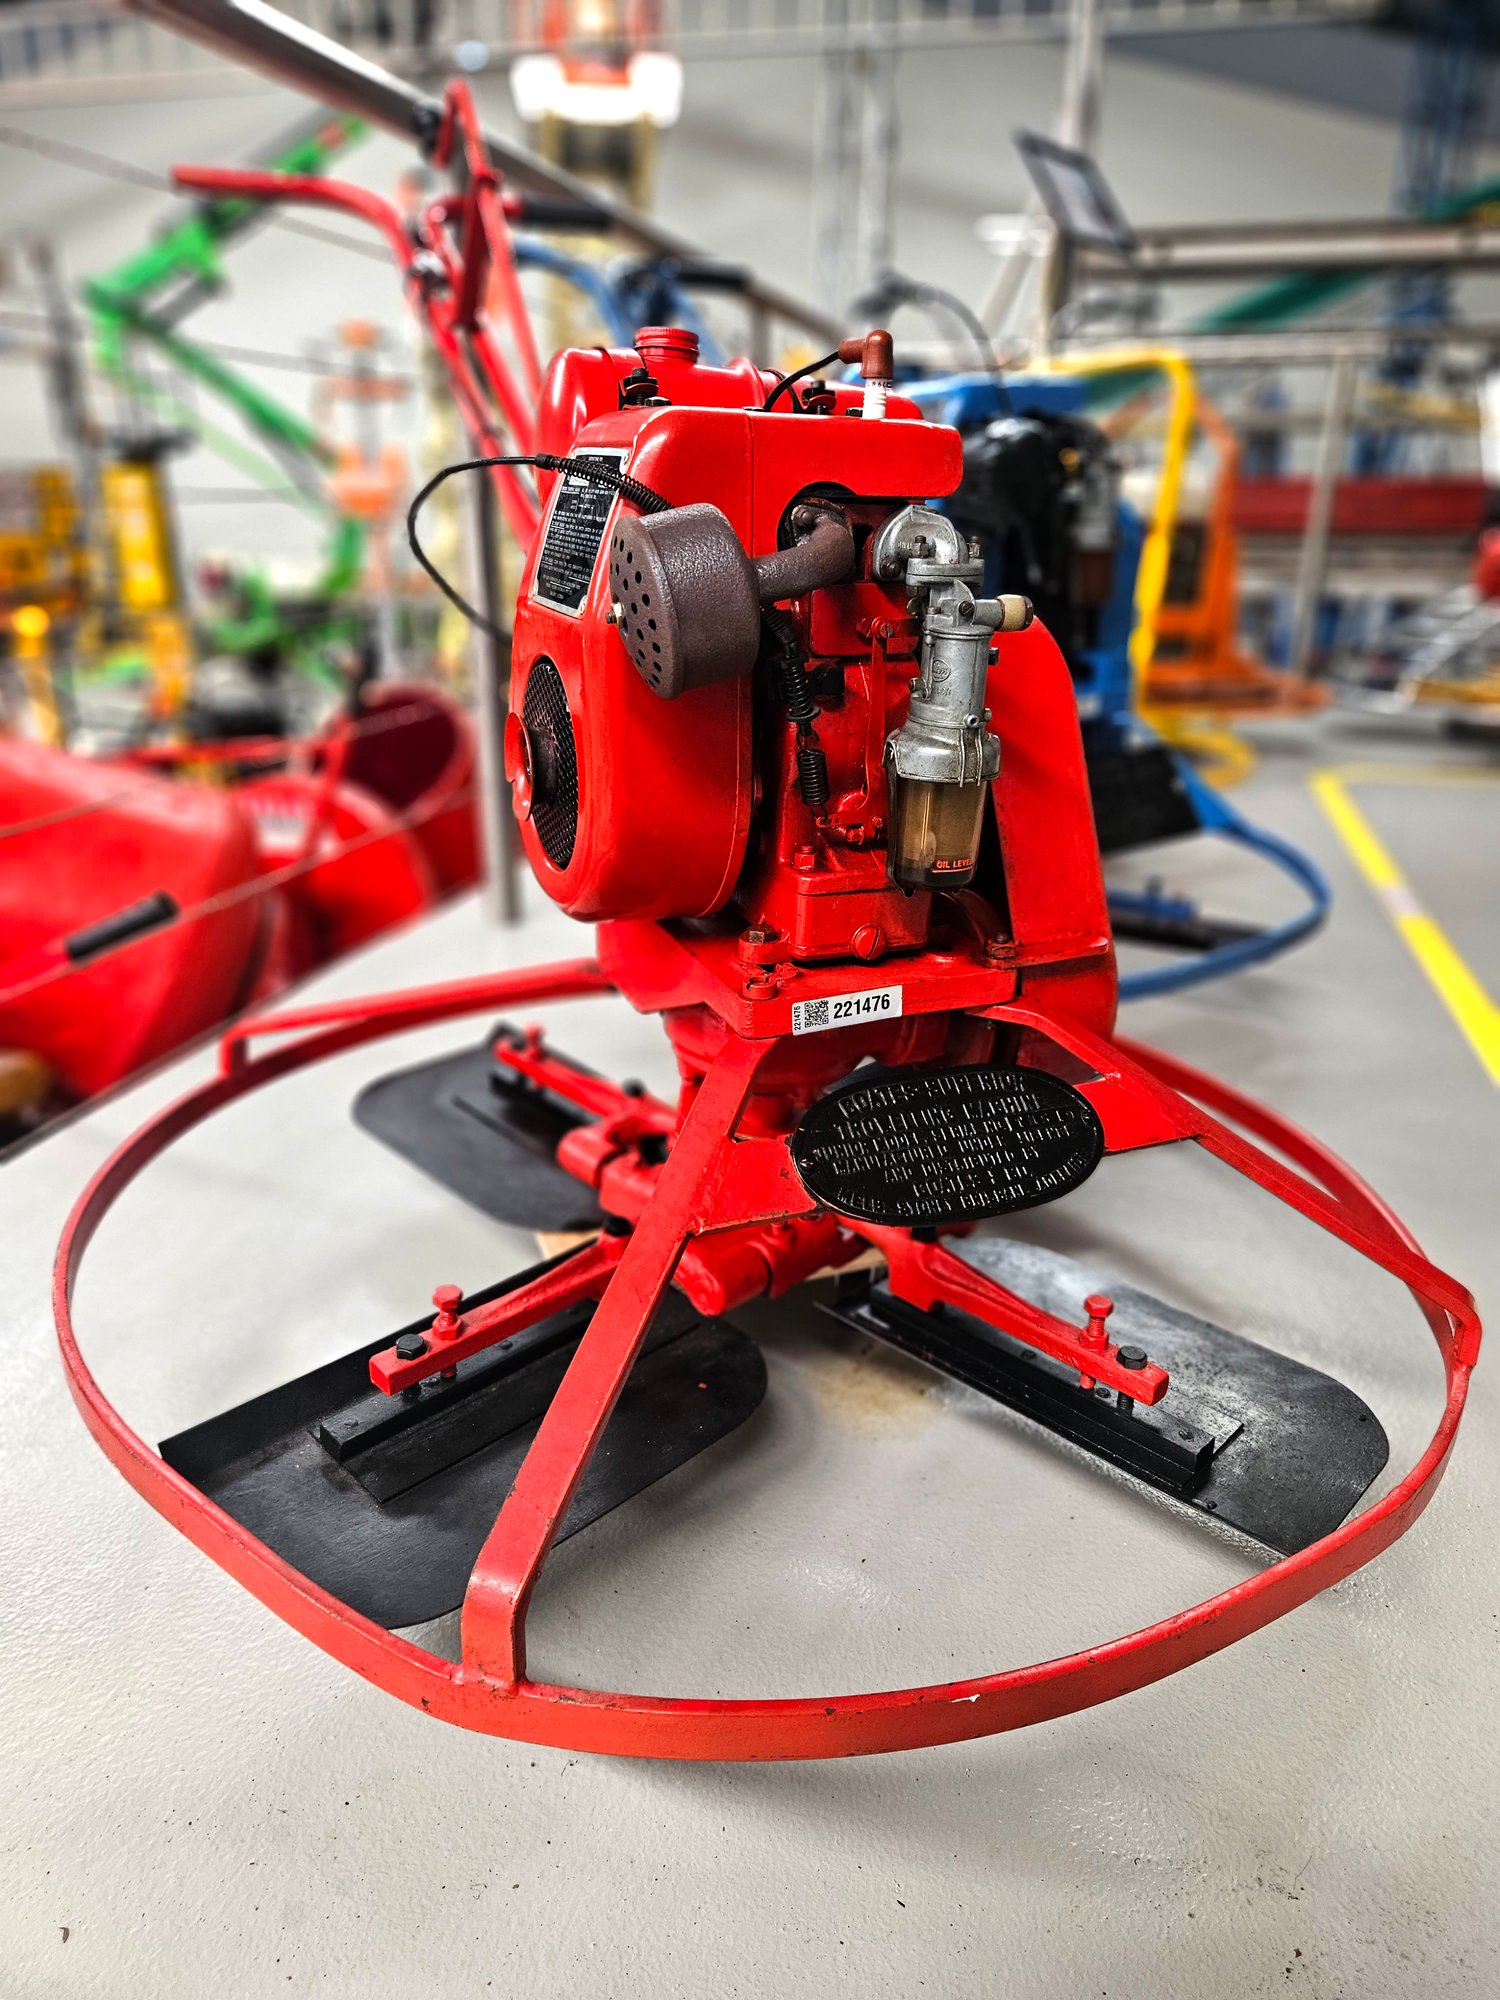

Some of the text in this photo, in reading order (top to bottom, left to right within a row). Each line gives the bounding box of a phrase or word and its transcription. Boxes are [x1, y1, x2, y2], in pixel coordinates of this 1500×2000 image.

[936, 858, 973, 869] OIL LEVE
[833, 993, 890, 1019] 221476
[837, 1072, 1025, 1118] COATES SUPERIOR
[832, 1093, 1041, 1140] TROWELLING MACHINE
[832, 1145, 948, 1175] MANUFACTURED
[958, 1134, 1007, 1153] UNDER
[884, 1145, 1040, 1183] AND DISTRIBUTED BY
[912, 1174, 981, 1198] COATES
